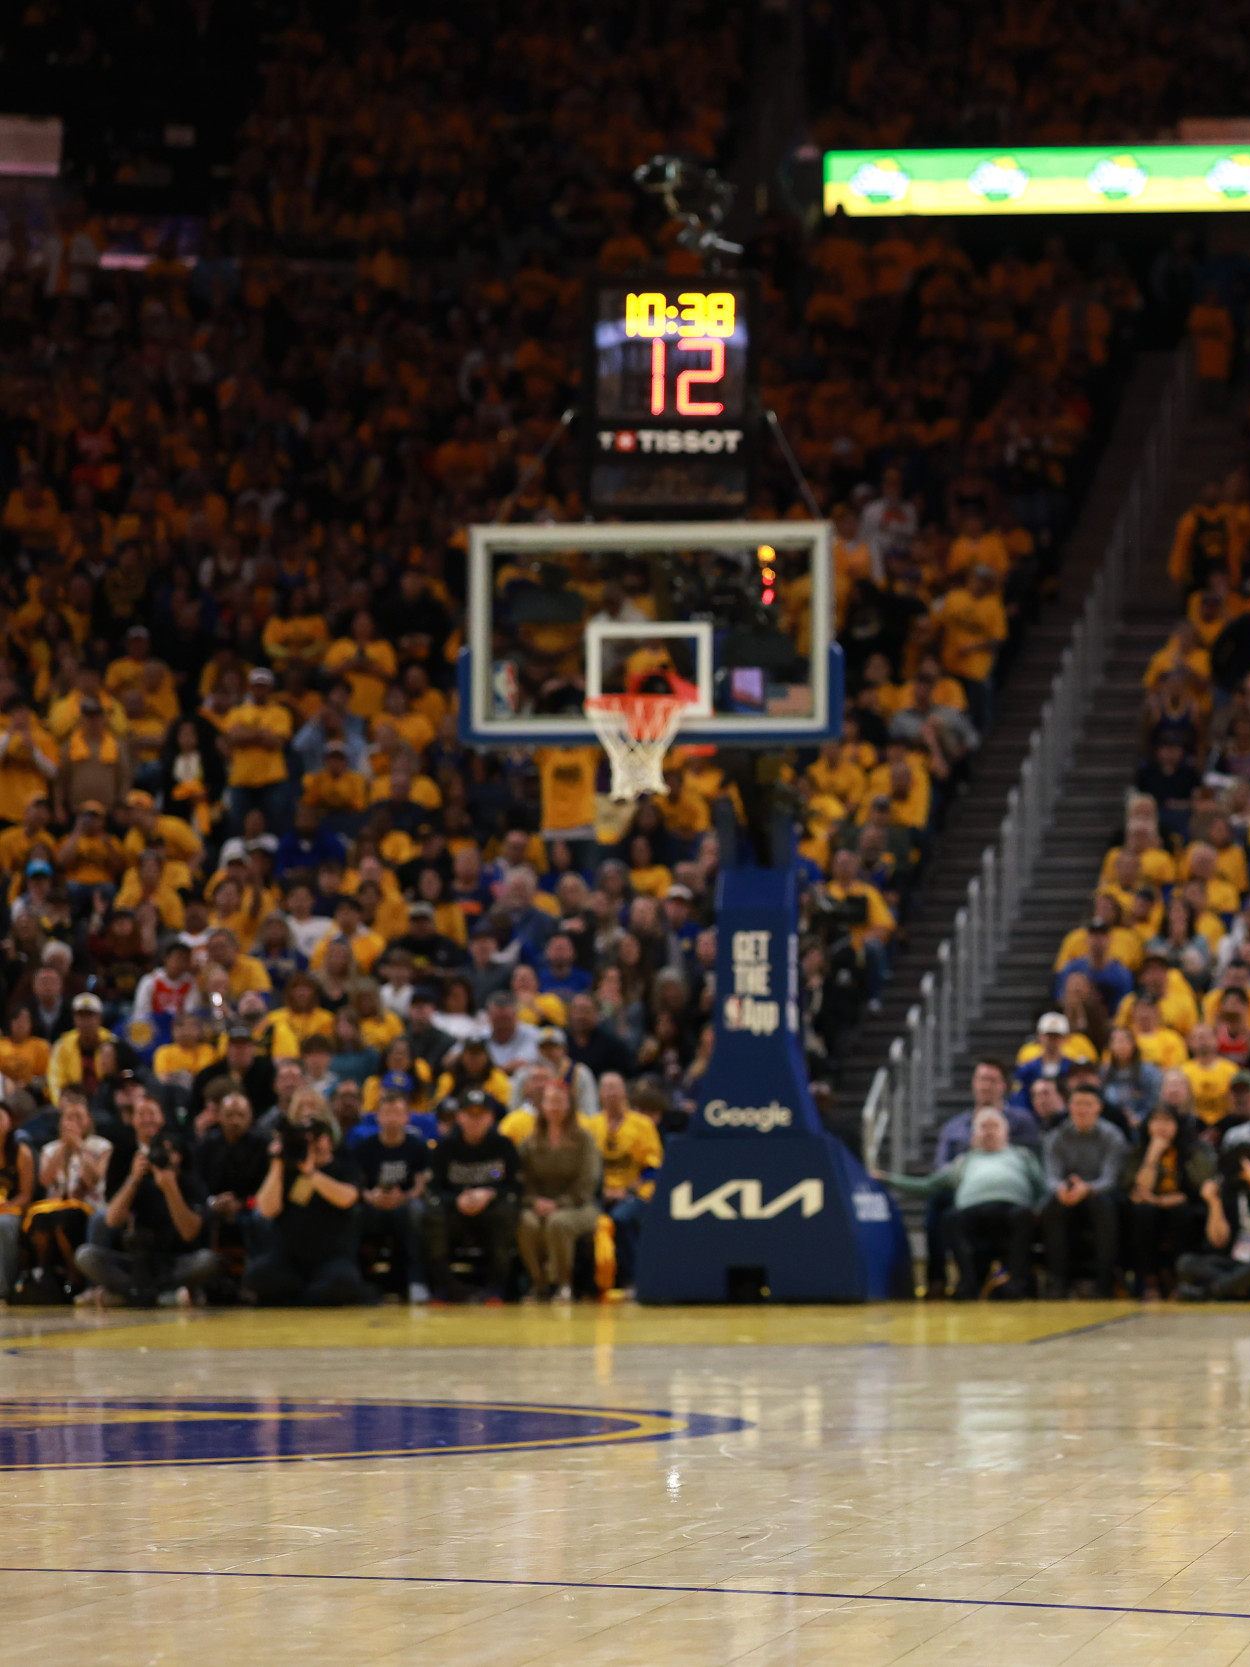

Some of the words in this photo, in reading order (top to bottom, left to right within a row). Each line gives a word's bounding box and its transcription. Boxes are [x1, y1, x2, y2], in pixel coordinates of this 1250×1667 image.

[626, 293, 735, 338] 10:38
[651, 338, 725, 416] 12
[638, 430, 742, 453] TISSOT
[732, 929, 771, 962] GET
[704, 1100, 791, 1132] Google
[669, 1177, 825, 1222] KIA
